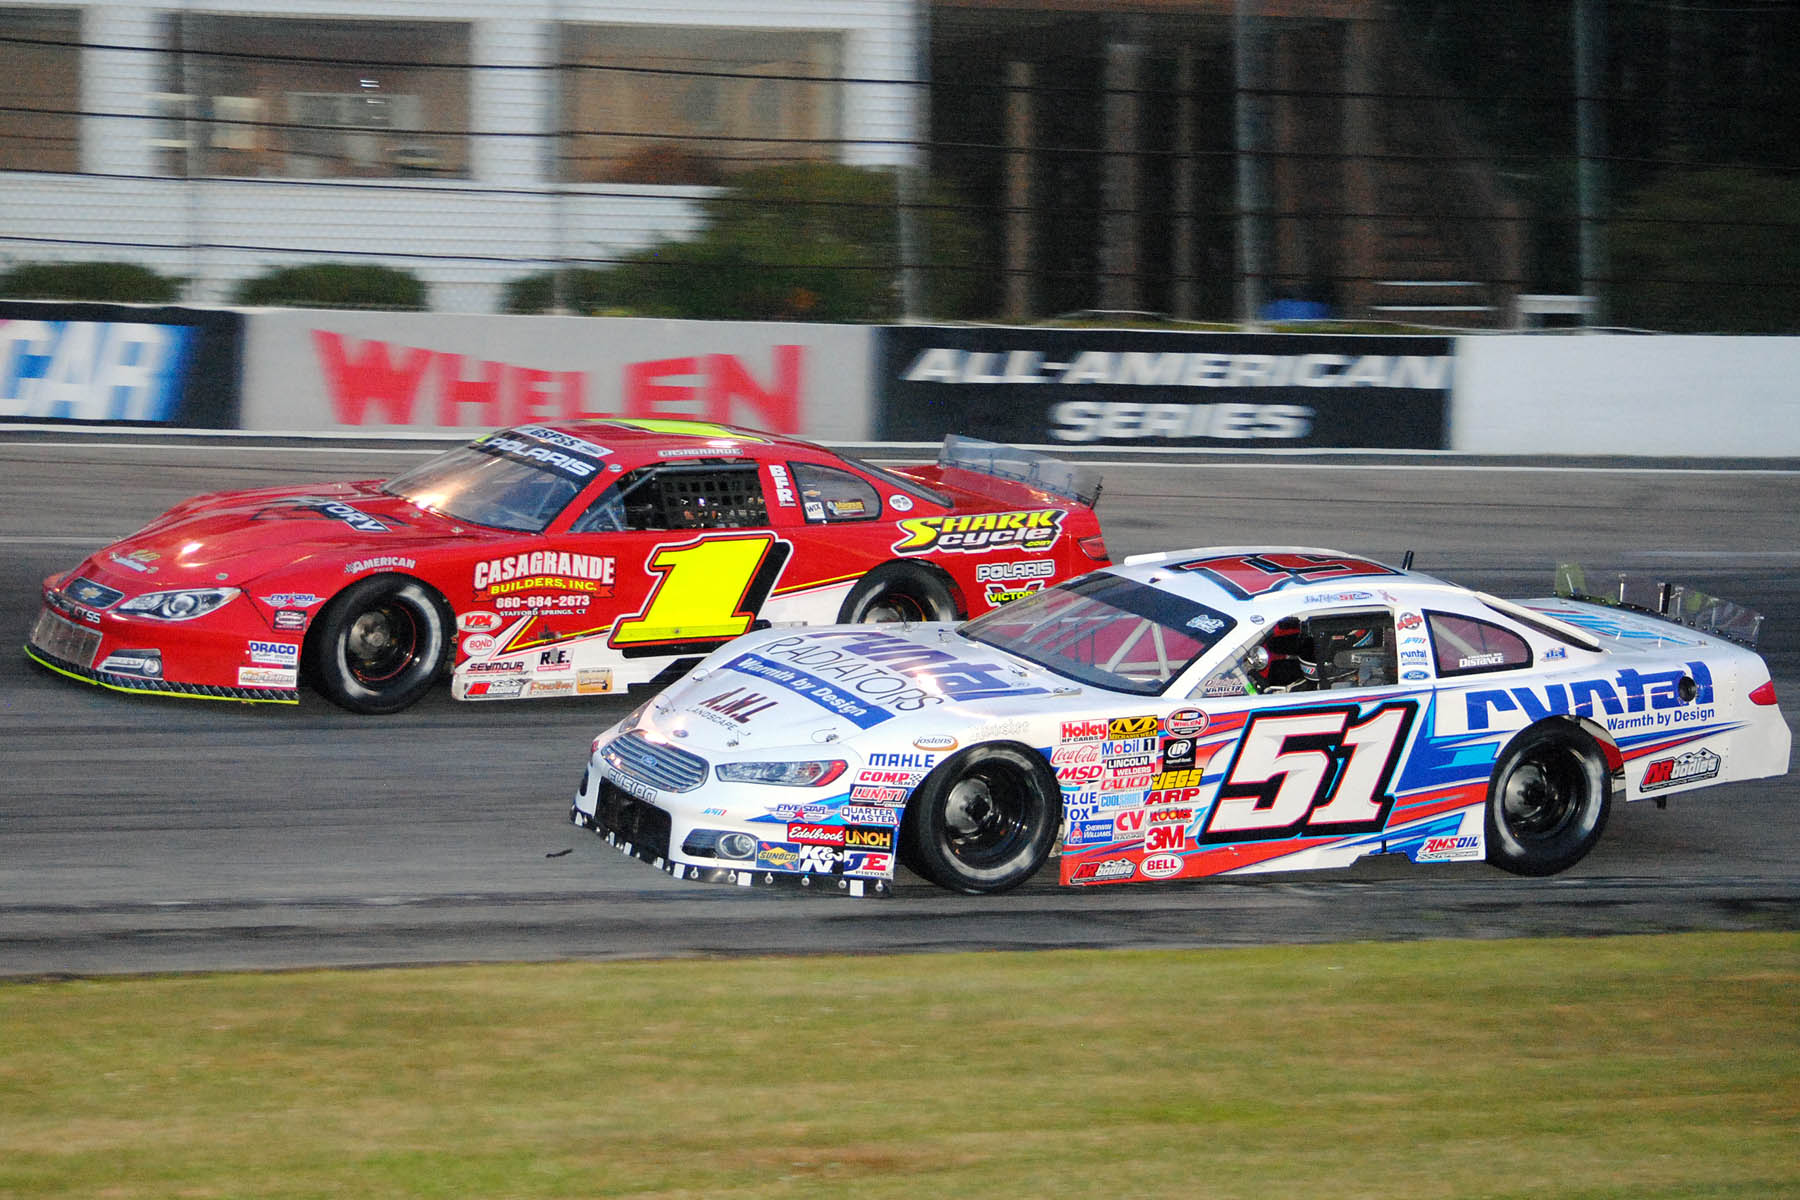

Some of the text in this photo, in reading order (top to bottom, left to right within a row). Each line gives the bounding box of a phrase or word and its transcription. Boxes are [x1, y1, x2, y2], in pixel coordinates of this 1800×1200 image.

[903, 348, 1450, 389] ALL-AMERICAN
[311, 329, 806, 434] WHELEN
[1049, 401, 1313, 441] SERIES
[485, 438, 597, 477] POLARIS
[893, 510, 1057, 549] SHARK
[937, 526, 1050, 547] cycle
[351, 557, 416, 574] AMERICAN
[474, 551, 616, 589] CASAGRANDE
[978, 562, 1053, 580] POLARIS
[490, 577, 598, 595] BUILDERS, INC.
[613, 537, 774, 643] 1
[250, 642, 296, 655] DRACO
[470, 639, 493, 650] BOND
[469, 661, 525, 672] SEYMOUR
[766, 637, 944, 711] RADIATORS
[738, 658, 868, 717] Warmth by Design
[1467, 661, 1714, 730] runtal
[1607, 707, 1715, 731] Warmth by Design
[1062, 722, 1107, 739] Holley
[916, 736, 952, 745] jostens
[1102, 739, 1139, 755] Mobil
[868, 753, 934, 768] MAHLE
[1108, 757, 1148, 769] LINCOLN
[859, 771, 910, 783] COMP
[1058, 766, 1103, 780] MSD
[1117, 766, 1151, 776] WELDERS
[1151, 769, 1203, 790] JEGS
[1206, 708, 1407, 834] 51
[608, 768, 658, 803] FUSION
[1101, 776, 1150, 791] CALICO
[853, 788, 903, 802] LUNATI
[1062, 791, 1097, 805] BLUE
[1145, 788, 1200, 805] ARP
[777, 803, 800, 812] FIVE
[802, 805, 826, 814] STAR
[842, 807, 893, 818] QUARTER
[1069, 807, 1089, 821] OX
[851, 815, 895, 824] MASTER
[1116, 810, 1144, 831] CV
[789, 827, 844, 842] Edelbrock
[845, 830, 891, 847] UNOH
[1146, 825, 1184, 850] 3M
[1424, 836, 1478, 853] AMSOIL
[759, 851, 798, 861] SUNOCO
[844, 852, 889, 872] JE
[1147, 858, 1177, 871] BELL
